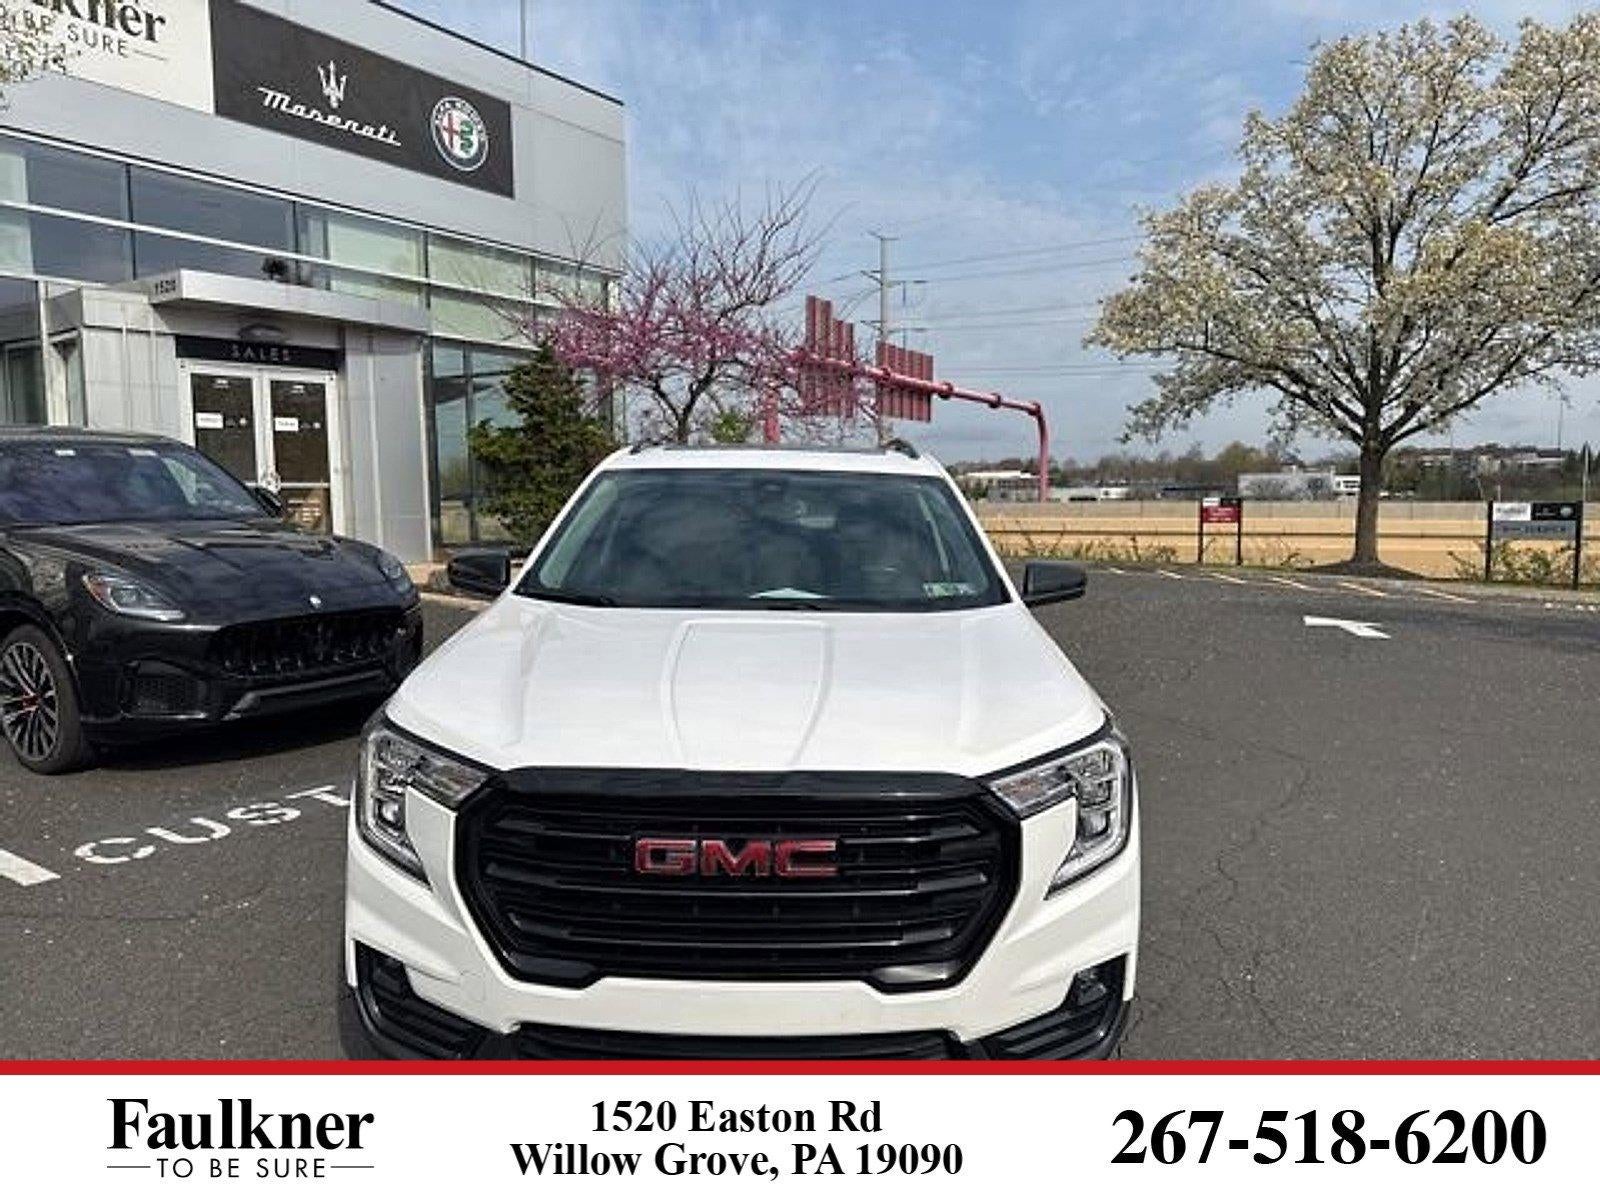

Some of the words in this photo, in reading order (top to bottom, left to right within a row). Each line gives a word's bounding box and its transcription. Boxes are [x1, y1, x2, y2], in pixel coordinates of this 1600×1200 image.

[67, 22, 129, 58] SURE
[257, 87, 401, 147] Maserati
[635, 837, 838, 877] GMC
